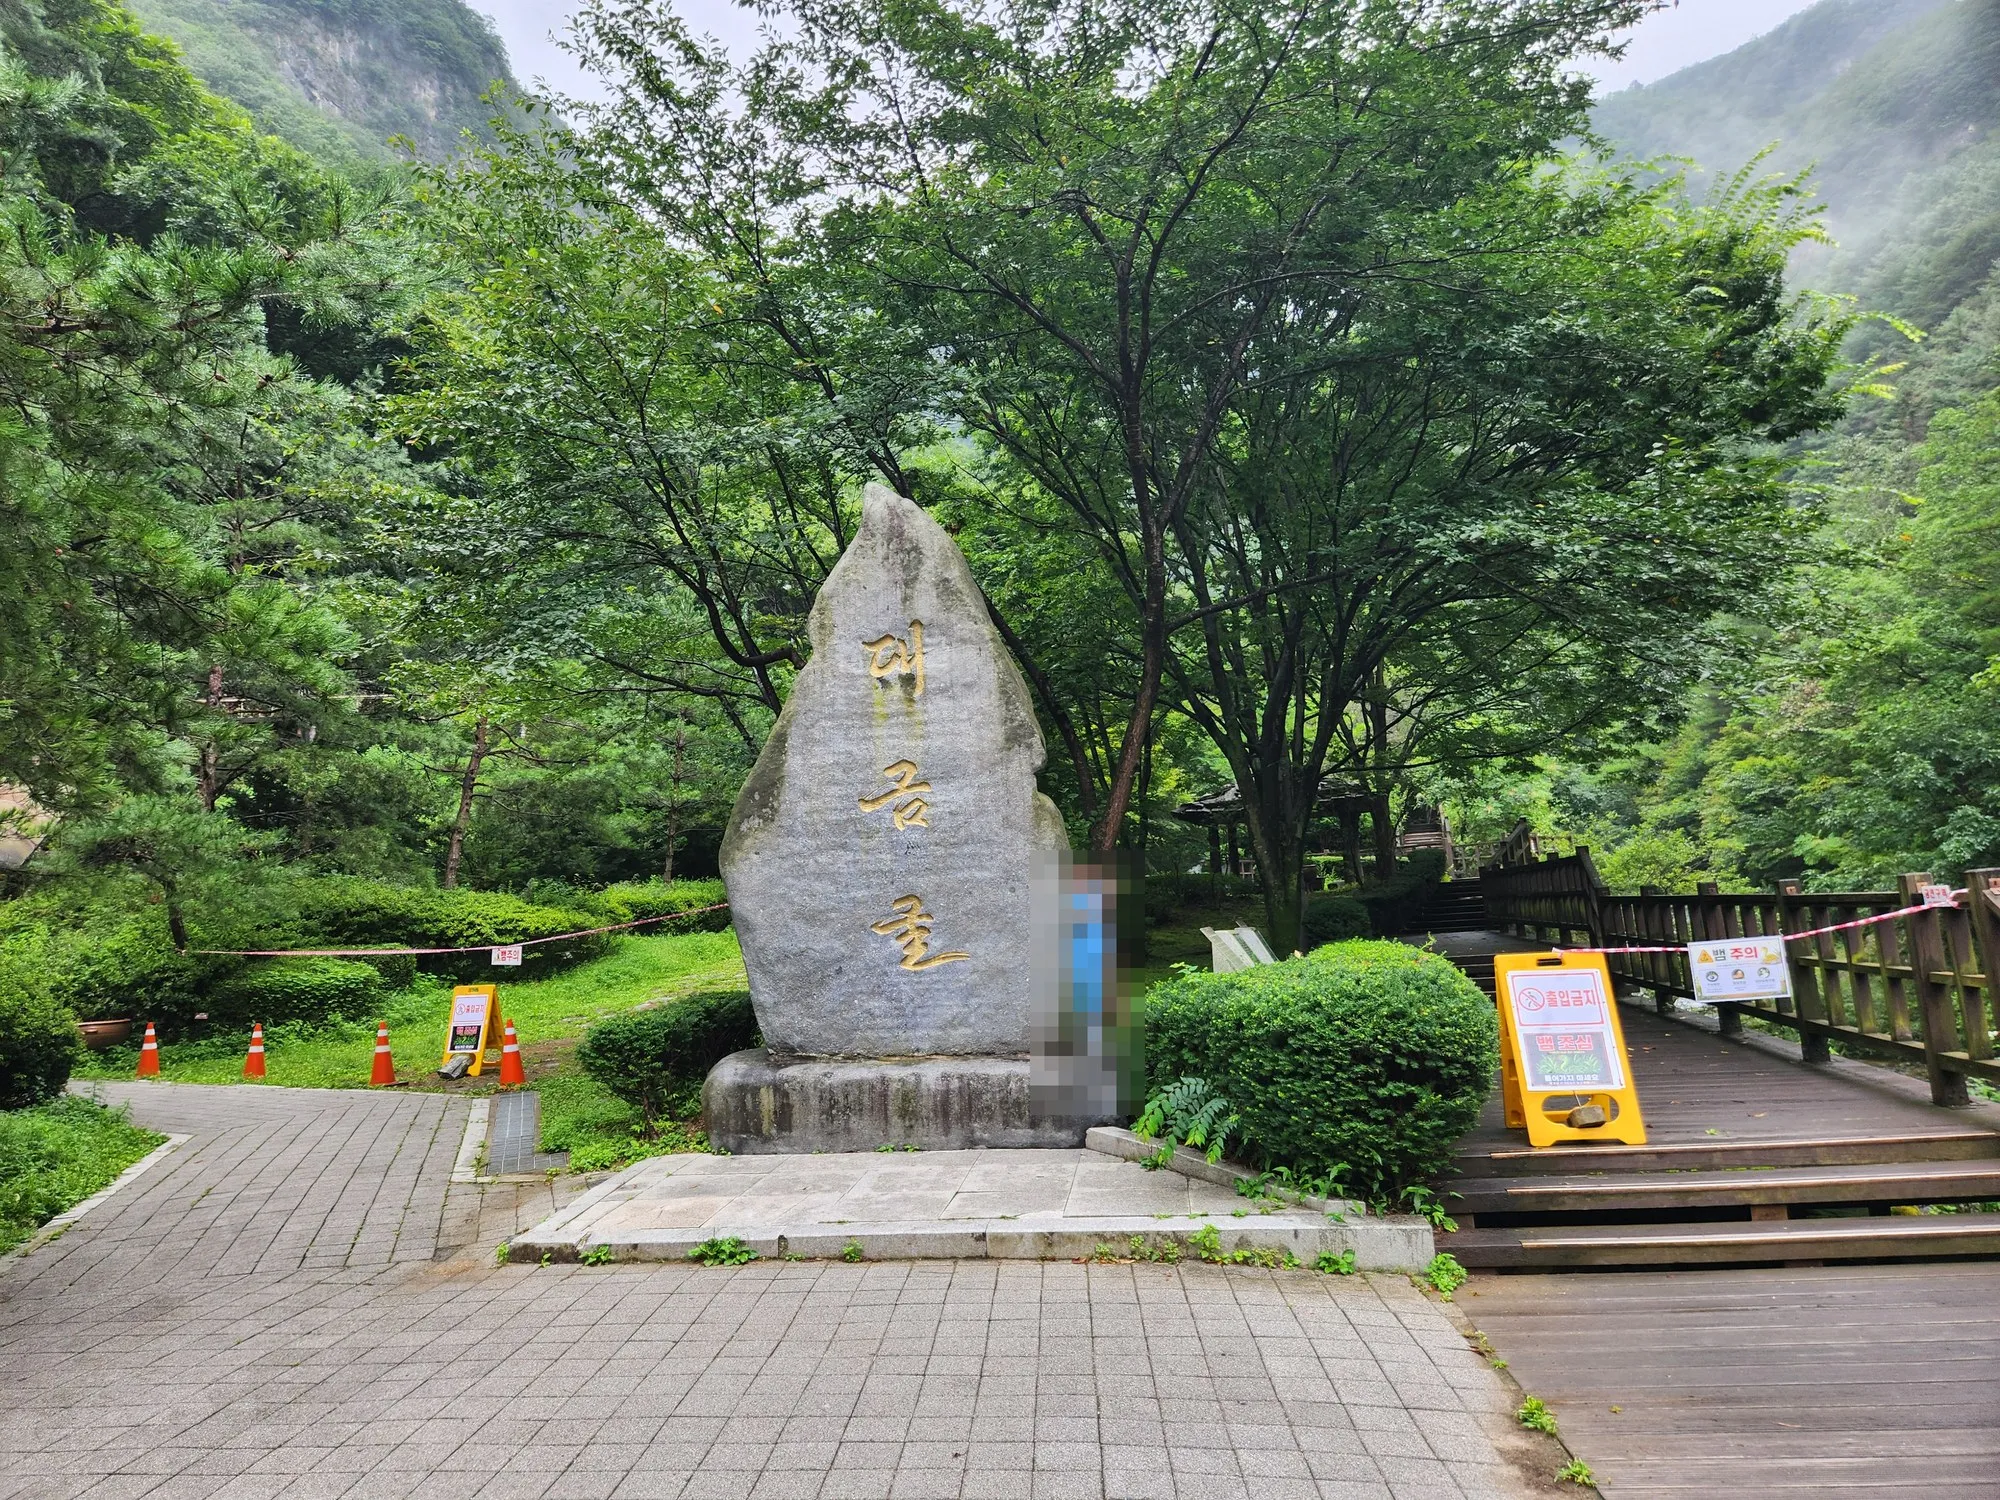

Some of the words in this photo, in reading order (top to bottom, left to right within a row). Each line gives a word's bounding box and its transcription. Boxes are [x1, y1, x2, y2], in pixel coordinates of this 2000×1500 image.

[858, 618, 972, 972] 대금굴
[1712, 948, 1727, 962] 뱀
[1730, 946, 1759, 960] 주의
[1546, 989, 1597, 1008] 출입금지
[1536, 1035, 1555, 1052] 뱀
[1557, 1034, 1594, 1051] 조심
